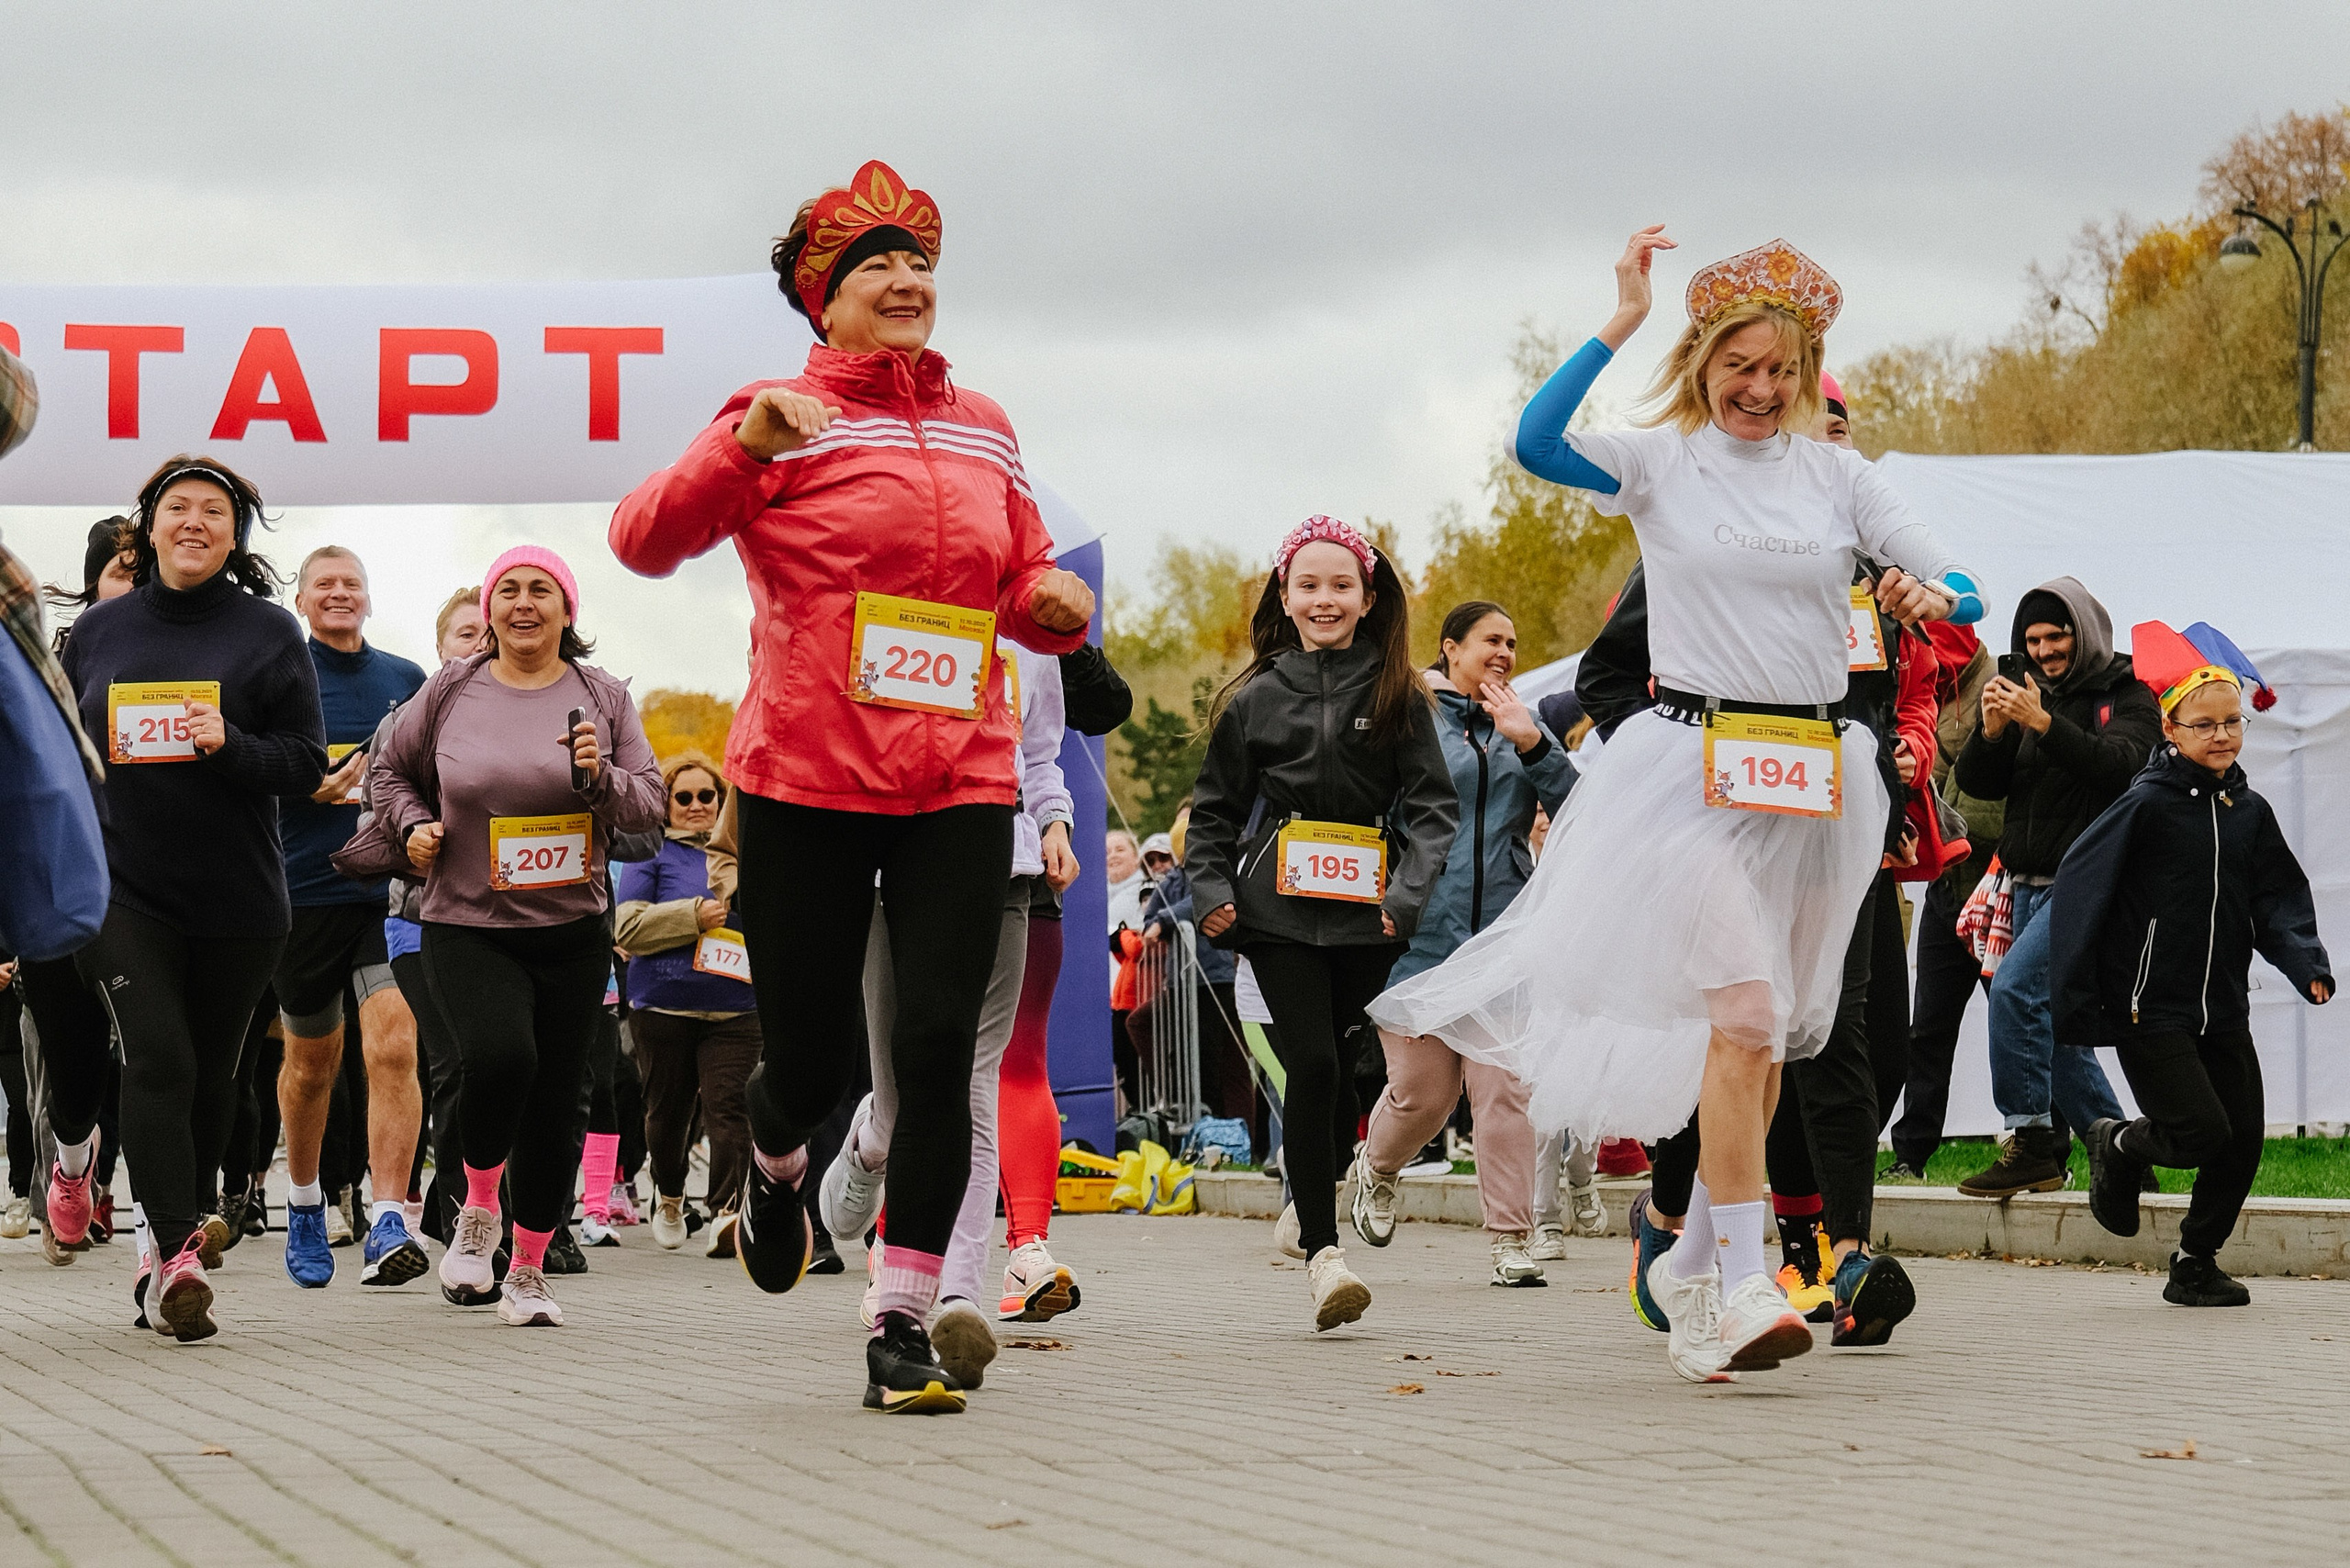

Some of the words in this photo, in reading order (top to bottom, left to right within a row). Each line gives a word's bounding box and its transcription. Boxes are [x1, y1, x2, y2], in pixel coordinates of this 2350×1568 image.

[0, 322, 664, 442] ТАРТ
[1713, 524, 1820, 556] Счастье
[899, 613, 915, 623] БЕЗ
[917, 616, 951, 631] ГРАНИЦ
[884, 645, 957, 688] 220
[139, 718, 192, 743] 215
[1747, 727, 1763, 735] БЕЗ
[1765, 729, 1799, 740] ГРАНИЦ
[1740, 756, 1808, 791] 194
[517, 846, 569, 871] 207
[1307, 854, 1360, 882] 195
[715, 948, 742, 966] 177
